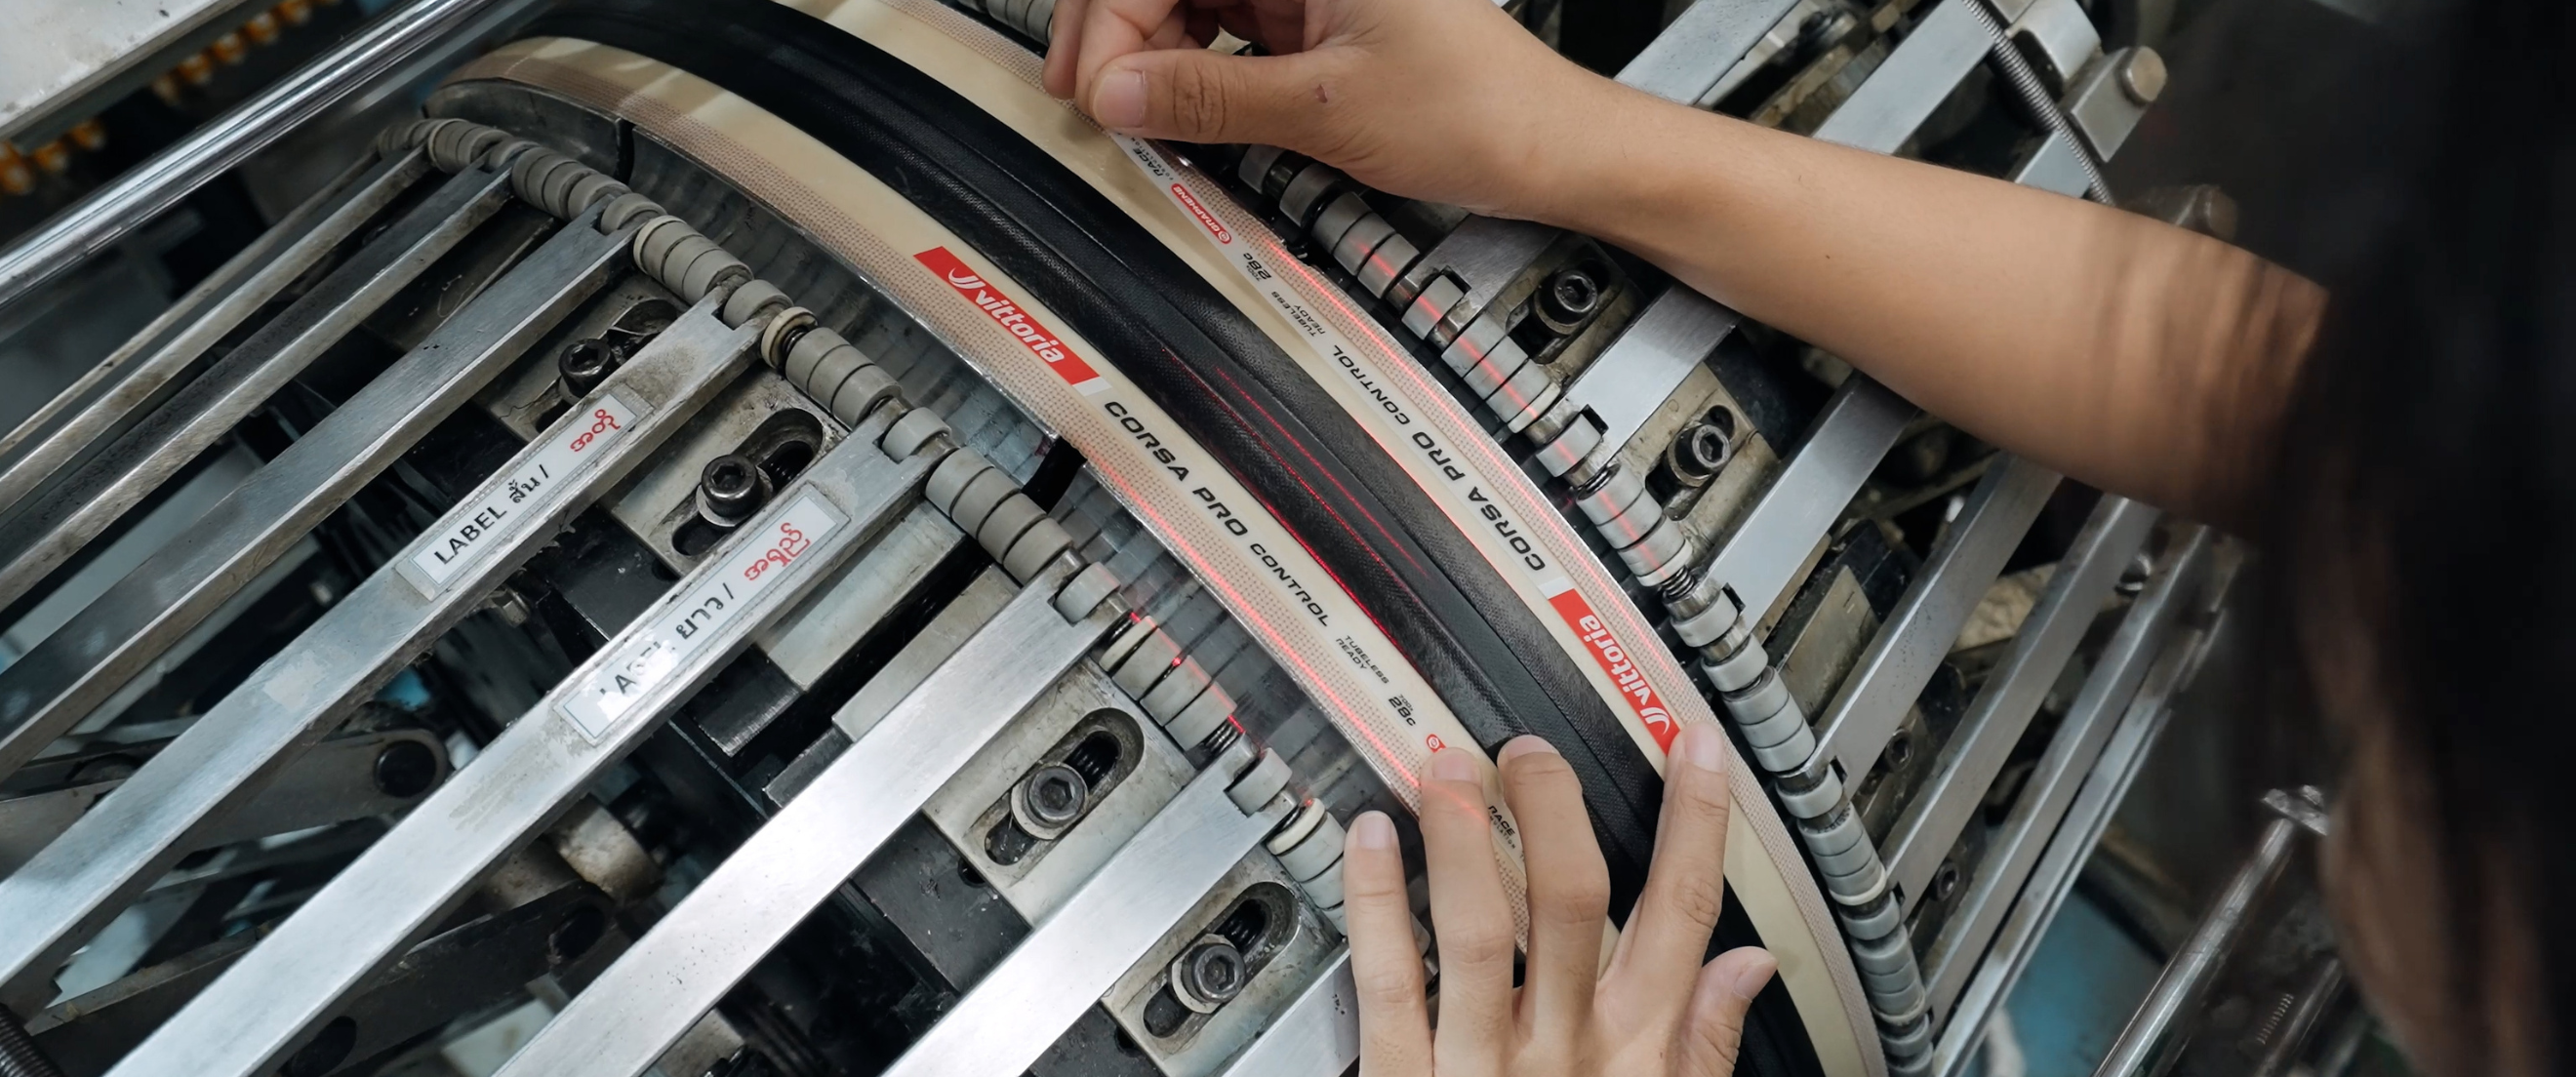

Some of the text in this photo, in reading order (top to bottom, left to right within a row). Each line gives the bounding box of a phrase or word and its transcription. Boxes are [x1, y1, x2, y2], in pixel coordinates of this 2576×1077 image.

[1132, 147, 1164, 177] RACE
[1173, 186, 1221, 232] GRAPHENE
[974, 288, 1066, 364] vittoria
[1271, 291, 1316, 338] TUBELESS
[1294, 304, 1326, 335] READY
[1333, 344, 1546, 571] CORSA PRO CONTROL
[433, 506, 507, 566] LABEL
[507, 476, 543, 504] สั้น
[1104, 401, 1329, 627] CORSA PRO CONTROL
[675, 595, 725, 641] ยาว
[1336, 638, 1367, 669] READY
[1345, 635, 1389, 684] TUBELESS
[1579, 615, 1651, 706] vittoria
[1488, 805, 1516, 836] RACE
